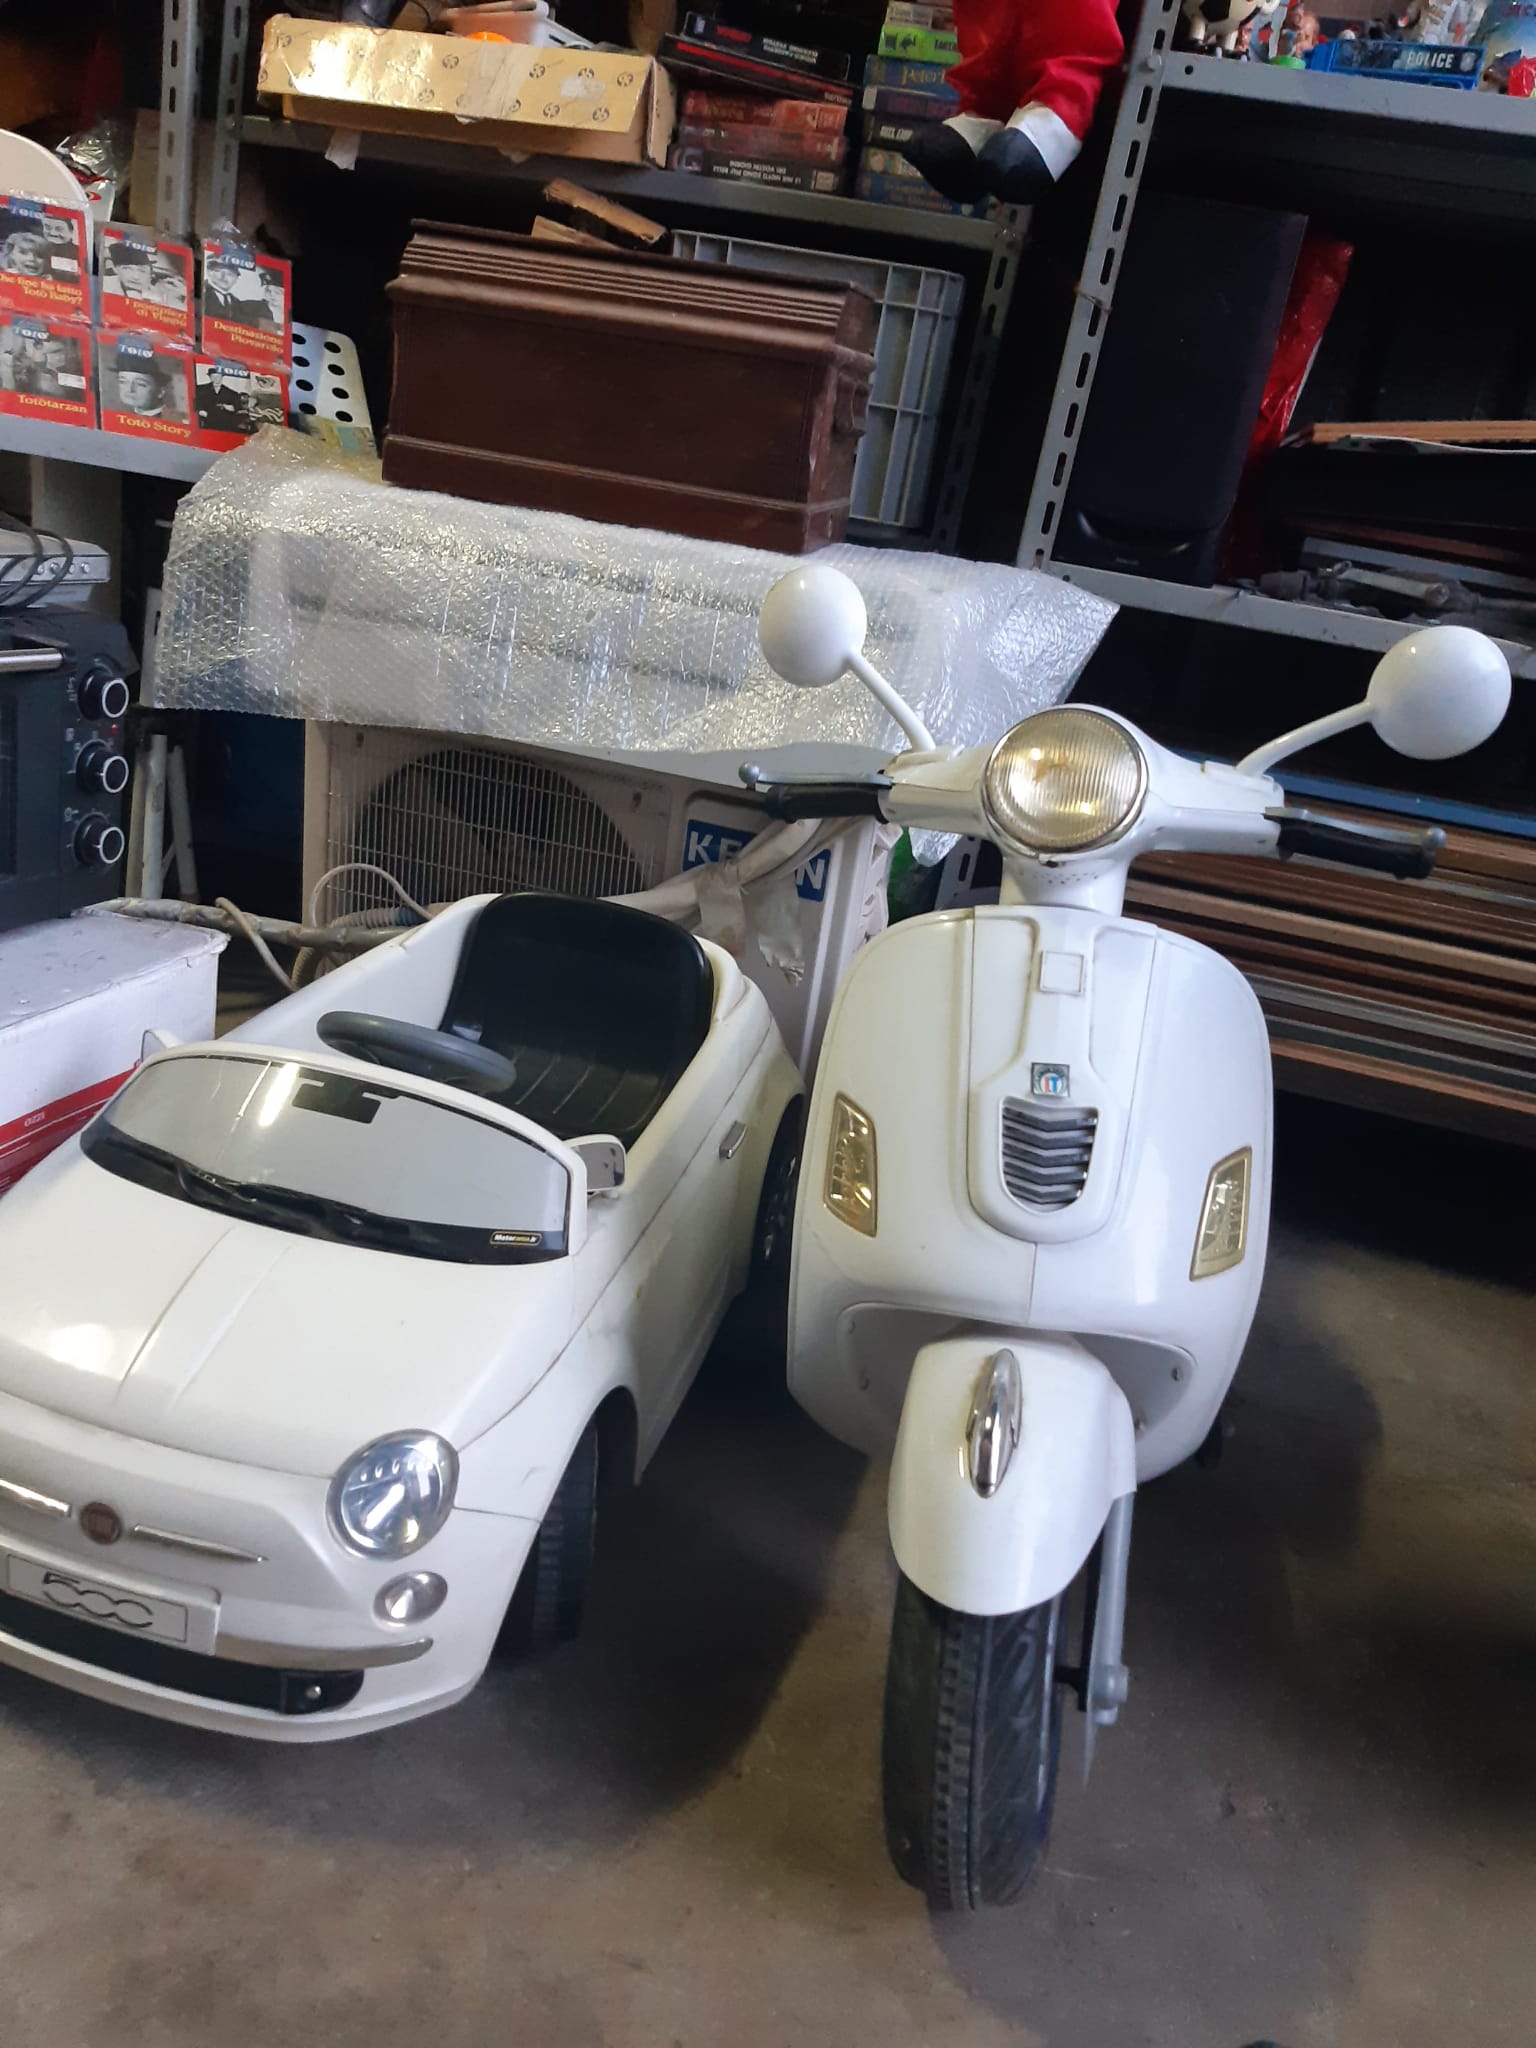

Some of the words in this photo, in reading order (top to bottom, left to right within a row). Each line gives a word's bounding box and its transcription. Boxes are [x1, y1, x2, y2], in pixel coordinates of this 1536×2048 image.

[1406, 50, 1455, 69] POLICE
[153, 420, 192, 438] Story
[42, 1571, 154, 1628] 500
